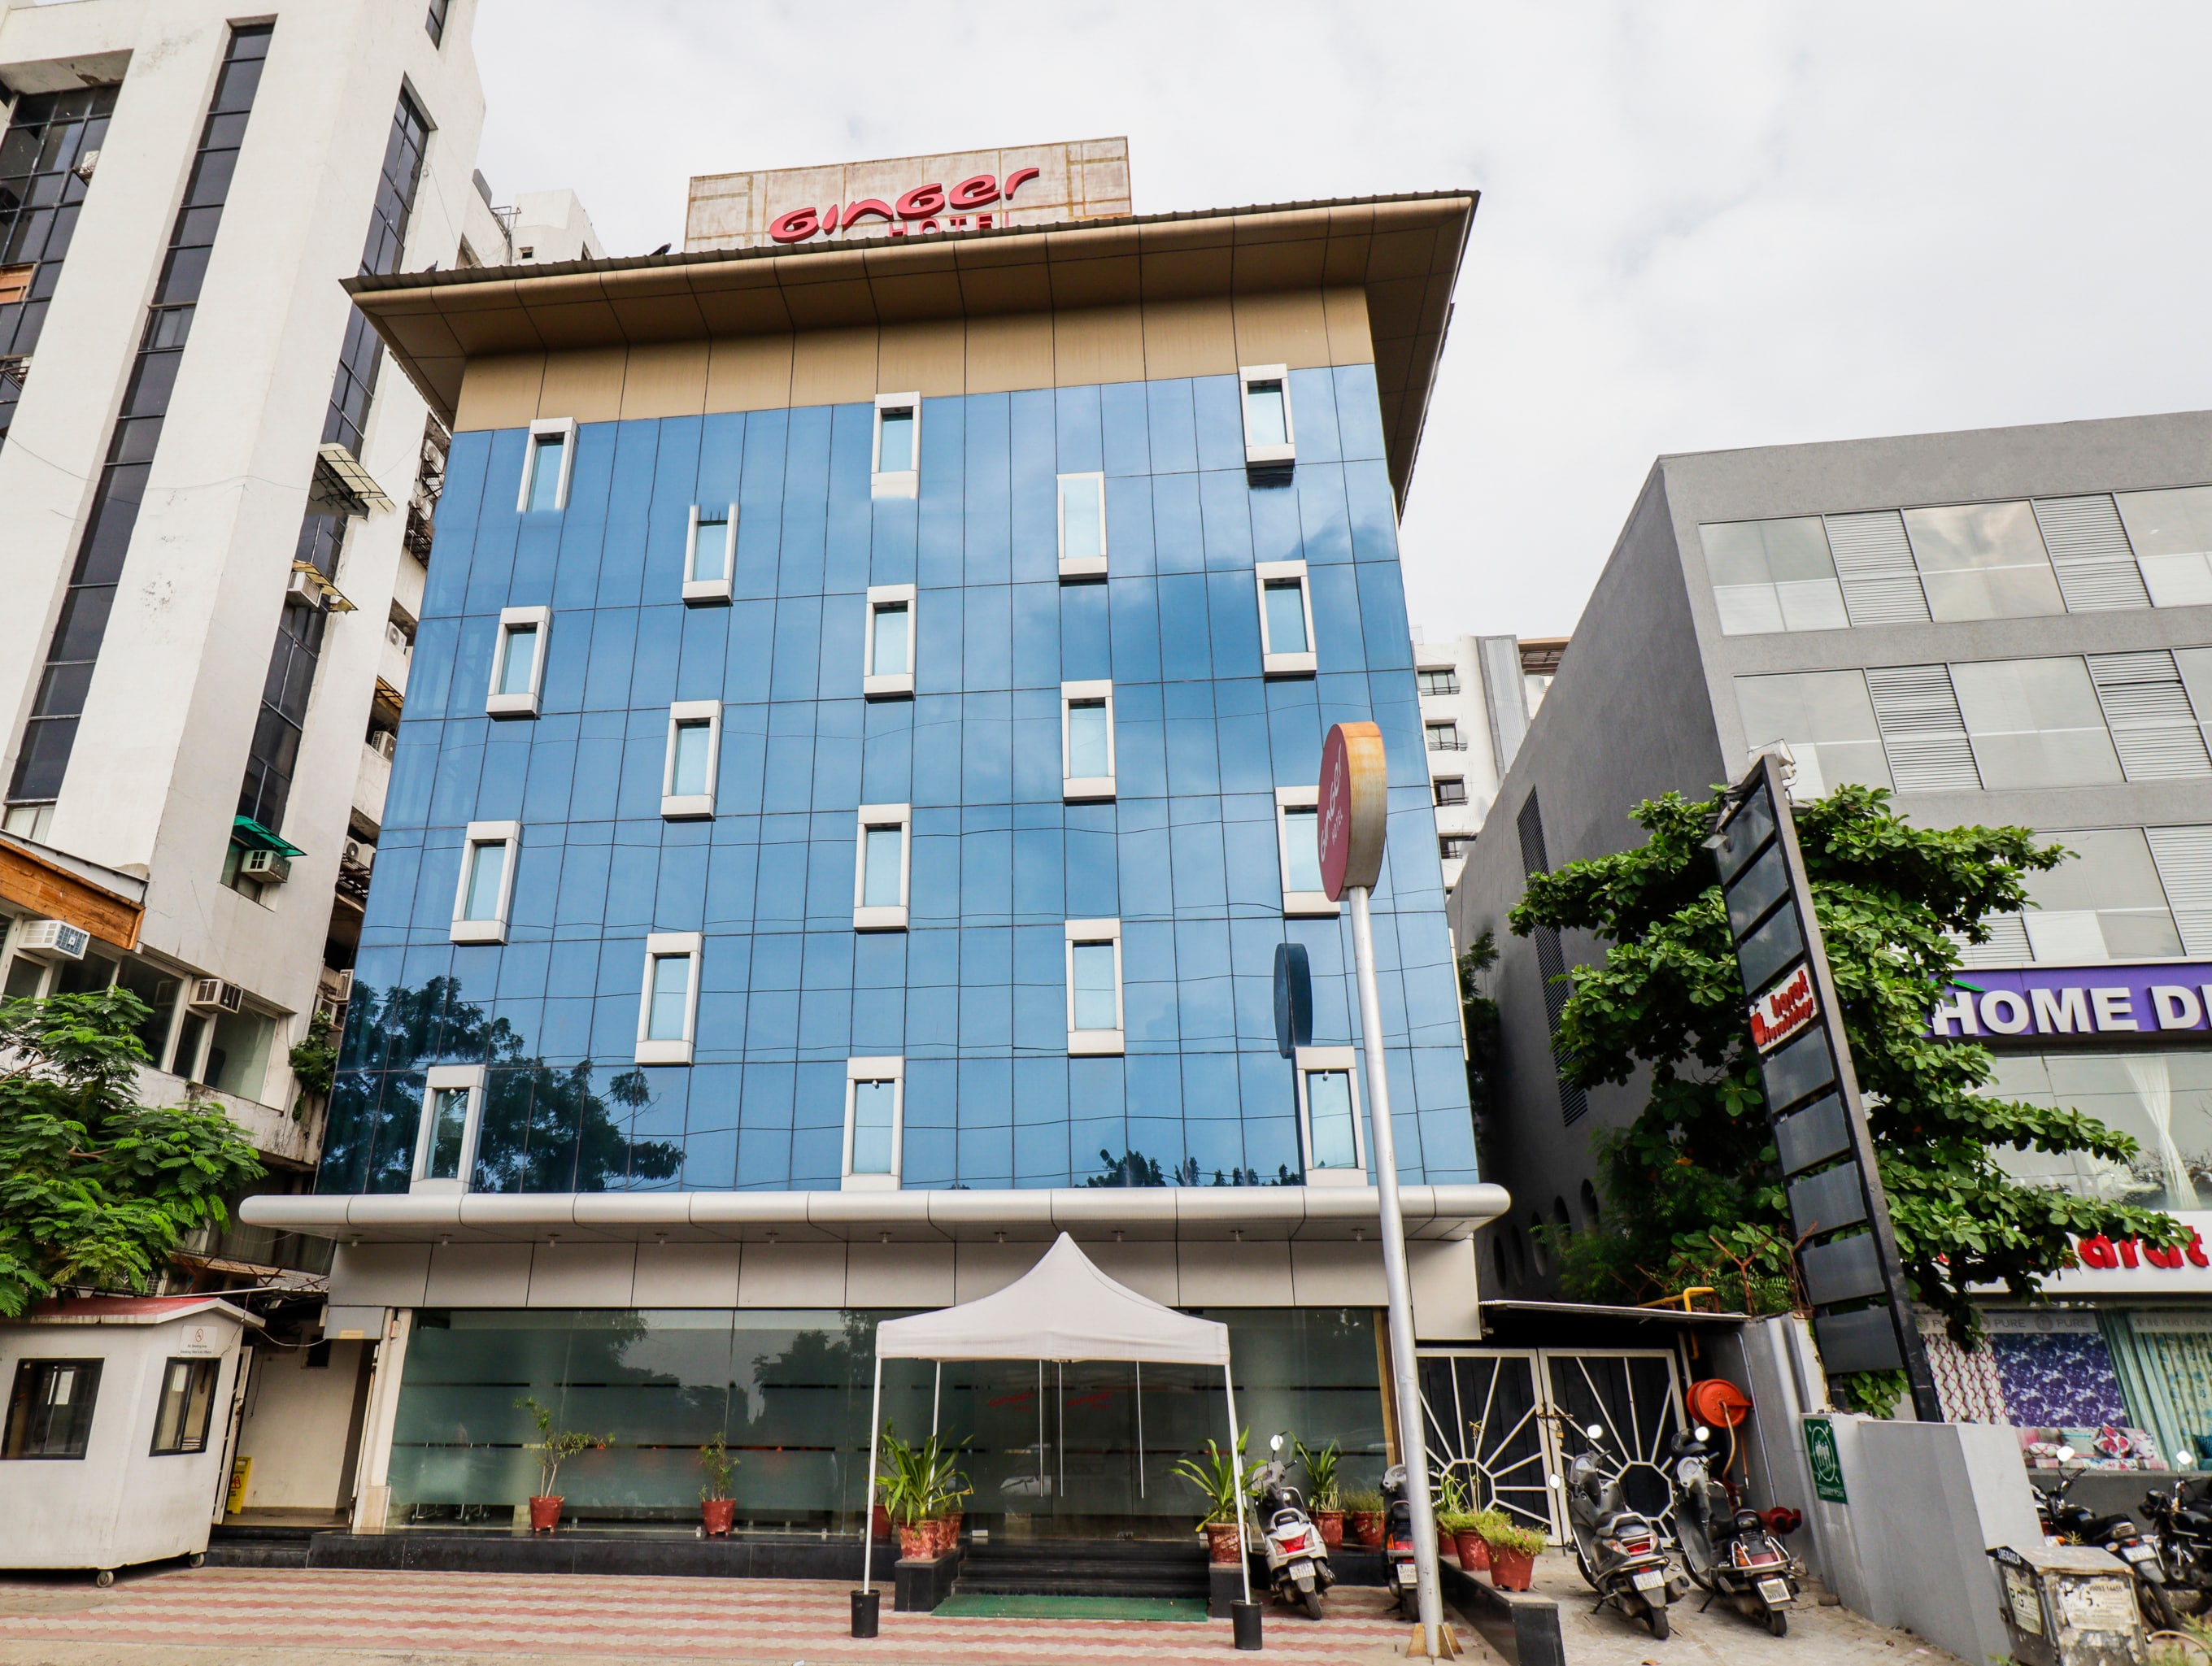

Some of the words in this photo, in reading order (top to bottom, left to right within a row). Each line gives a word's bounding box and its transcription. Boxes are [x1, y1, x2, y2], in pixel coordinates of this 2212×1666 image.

[1931, 987, 2140, 1036] HOME
[1994, 1318, 2027, 1328] PURE
[2055, 1318, 2089, 1328] PURE
